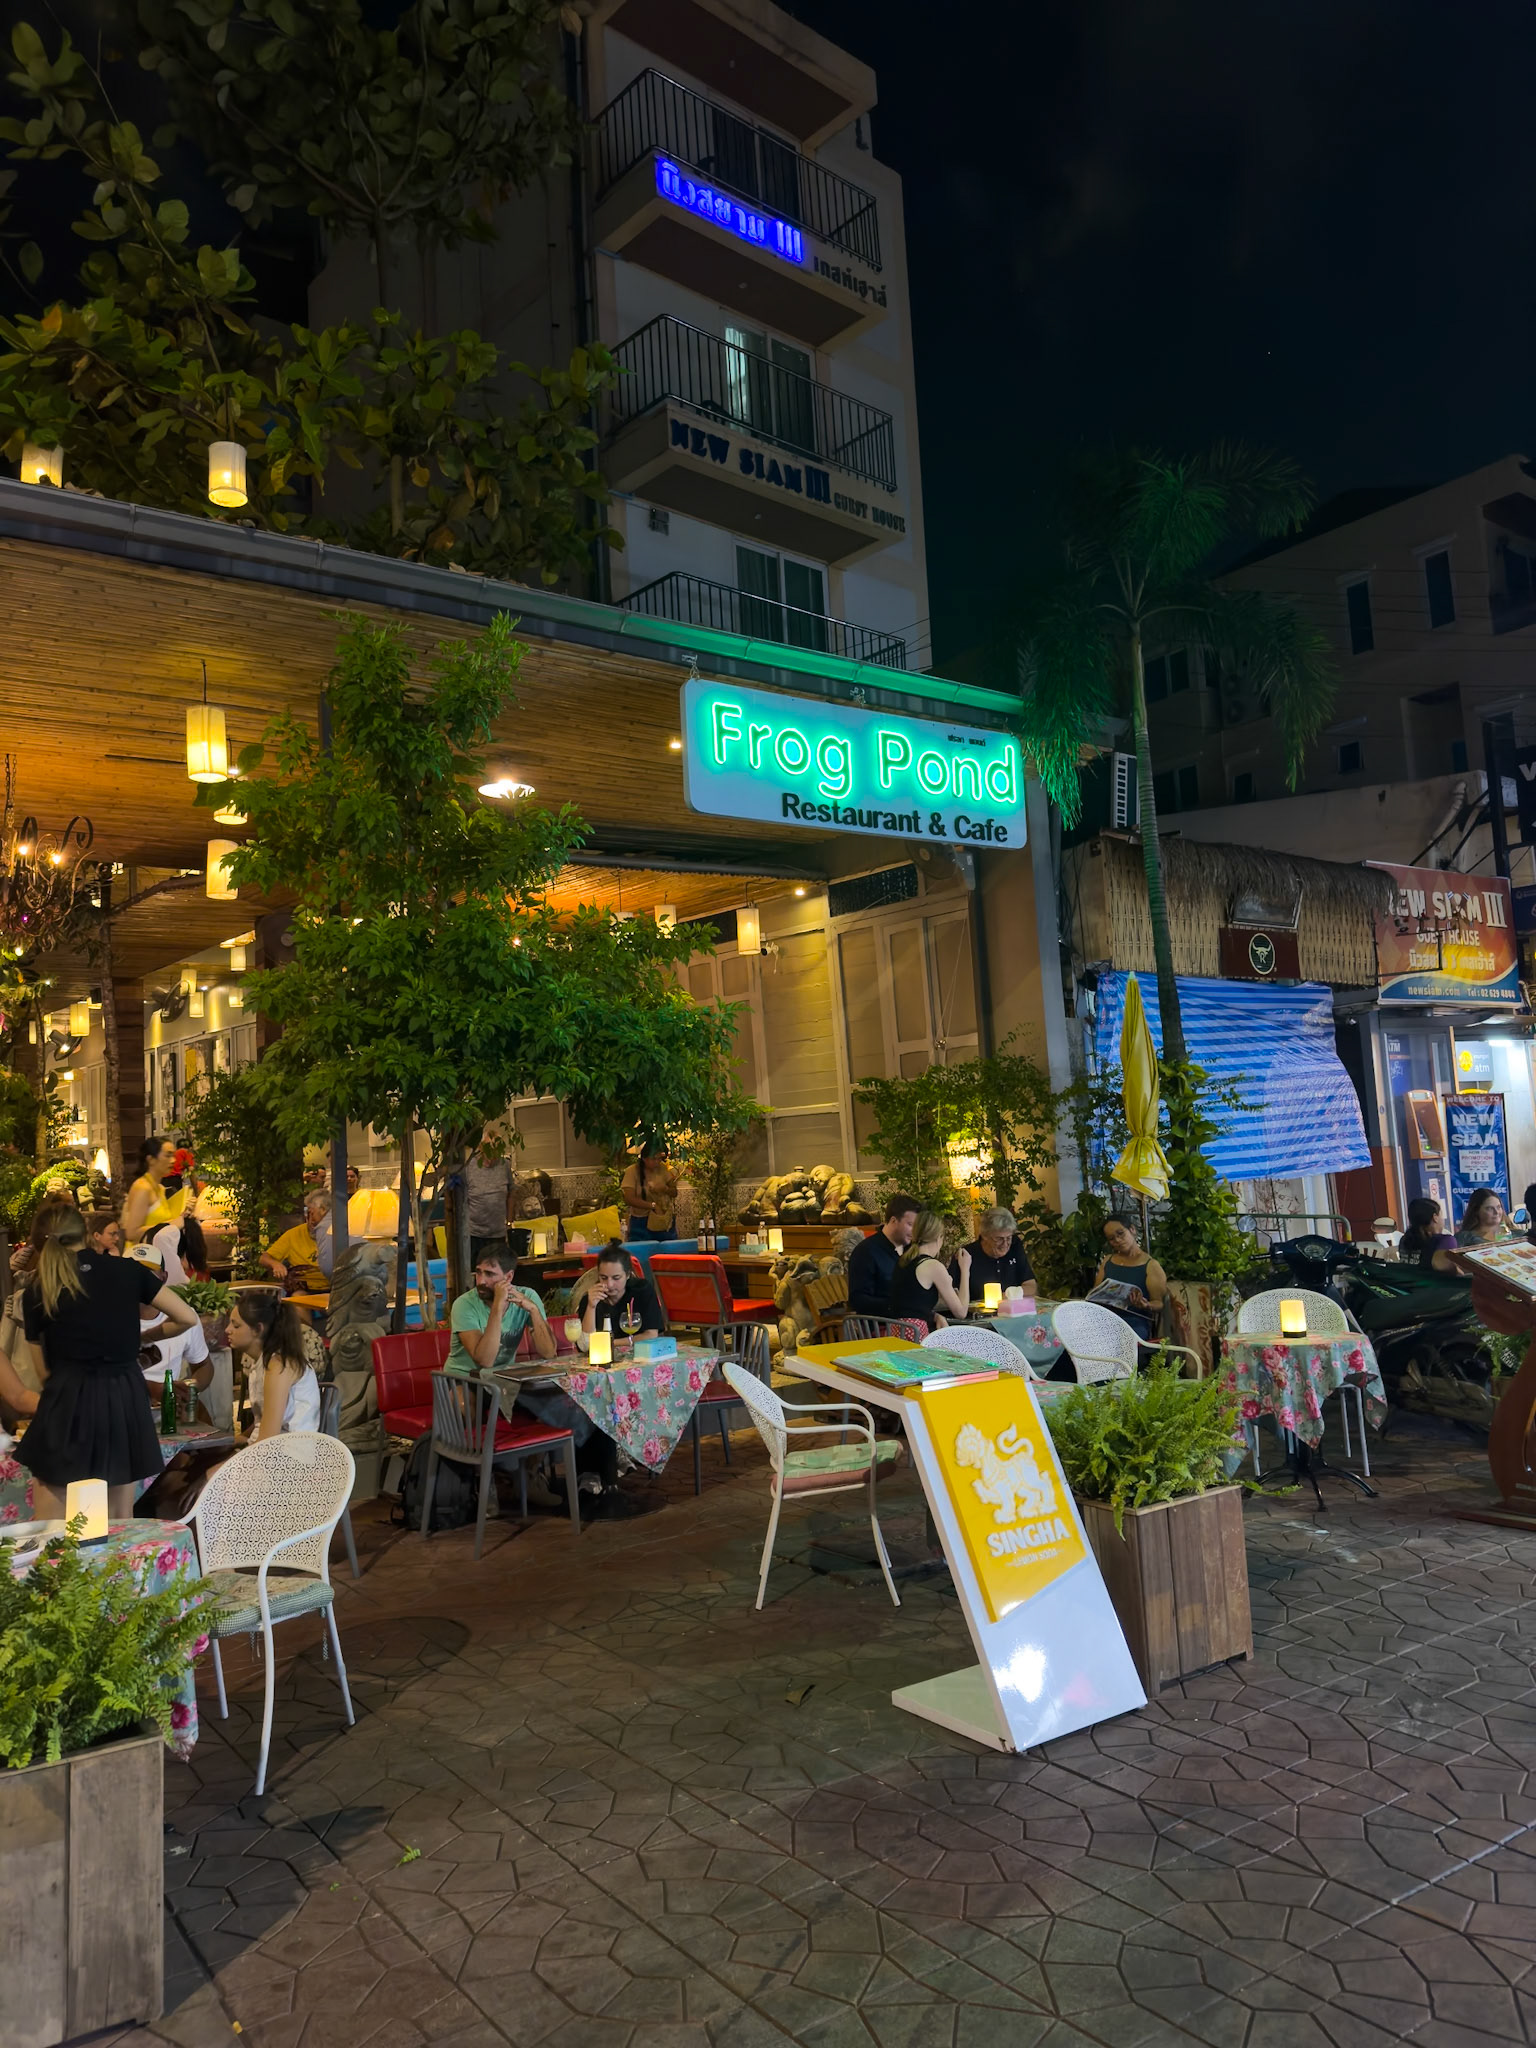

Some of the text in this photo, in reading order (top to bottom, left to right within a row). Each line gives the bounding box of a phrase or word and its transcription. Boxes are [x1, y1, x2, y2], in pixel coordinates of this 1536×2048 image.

[670, 418, 730, 464] NEW
[739, 448, 802, 493] SIAM
[833, 493, 906, 533] GUEST HOUSE
[711, 701, 1018, 803] Frog Pond
[781, 792, 1009, 843] Restaurant & Cafe
[1481, 890, 1508, 929] III
[1474, 1063, 1490, 1073] atm
[1451, 1133, 1499, 1147] SIAM
[1452, 1113, 1495, 1127] NEW
[987, 1517, 1071, 1557] SINGHA
